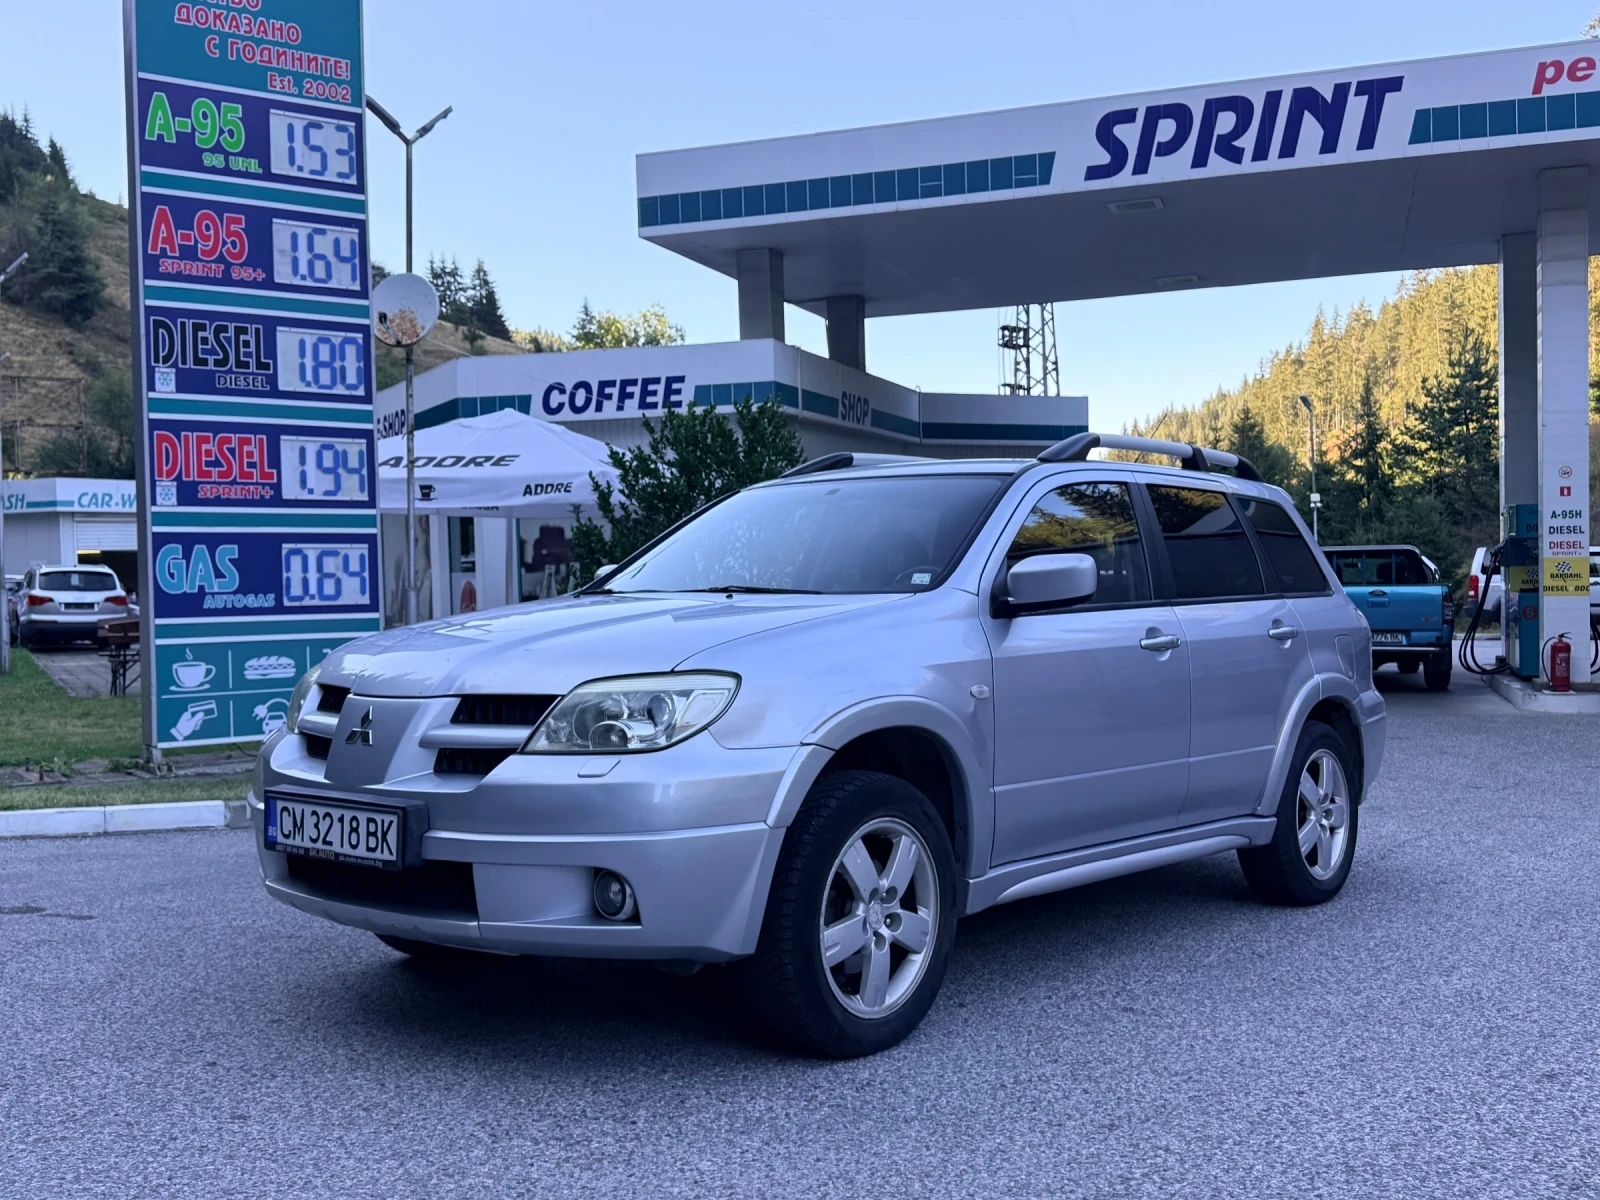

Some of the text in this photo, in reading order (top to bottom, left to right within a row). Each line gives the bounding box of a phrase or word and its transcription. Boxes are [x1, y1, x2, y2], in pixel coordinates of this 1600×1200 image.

[175, 3, 301, 44] ДОКАЗАНО
[205, 35, 350, 80] С ГОДИНИТЕ!
[1532, 56, 1600, 95] pe
[267, 72, 351, 102] Est. 2002
[145, 91, 245, 152] A-95
[1084, 76, 1404, 181] SPRINT
[202, 152, 262, 173] 95 UNL
[287, 121, 355, 180] 1.53
[148, 205, 248, 262] A-95
[159, 259, 265, 281] SPRINT 95+
[290, 228, 357, 284] 1.64
[151, 316, 273, 374] DIESEL
[299, 336, 363, 391] 1.80
[216, 373, 270, 390] DIESEL
[542, 375, 686, 416] COFFEE
[841, 391, 869, 426] SHOP
[154, 431, 277, 483] DIESEL
[299, 443, 366, 497] 1.94
[379, 454, 520, 468] ADORE
[198, 484, 274, 499] SPRINT+
[523, 481, 573, 497] ADORE
[1549, 525, 1584, 535] DIESEL
[1549, 541, 1584, 550] DIESEL
[156, 543, 239, 594] GAS
[284, 547, 367, 602] 0.64
[203, 593, 275, 609] AUTOGAS
[268, 825, 277, 837] BG
